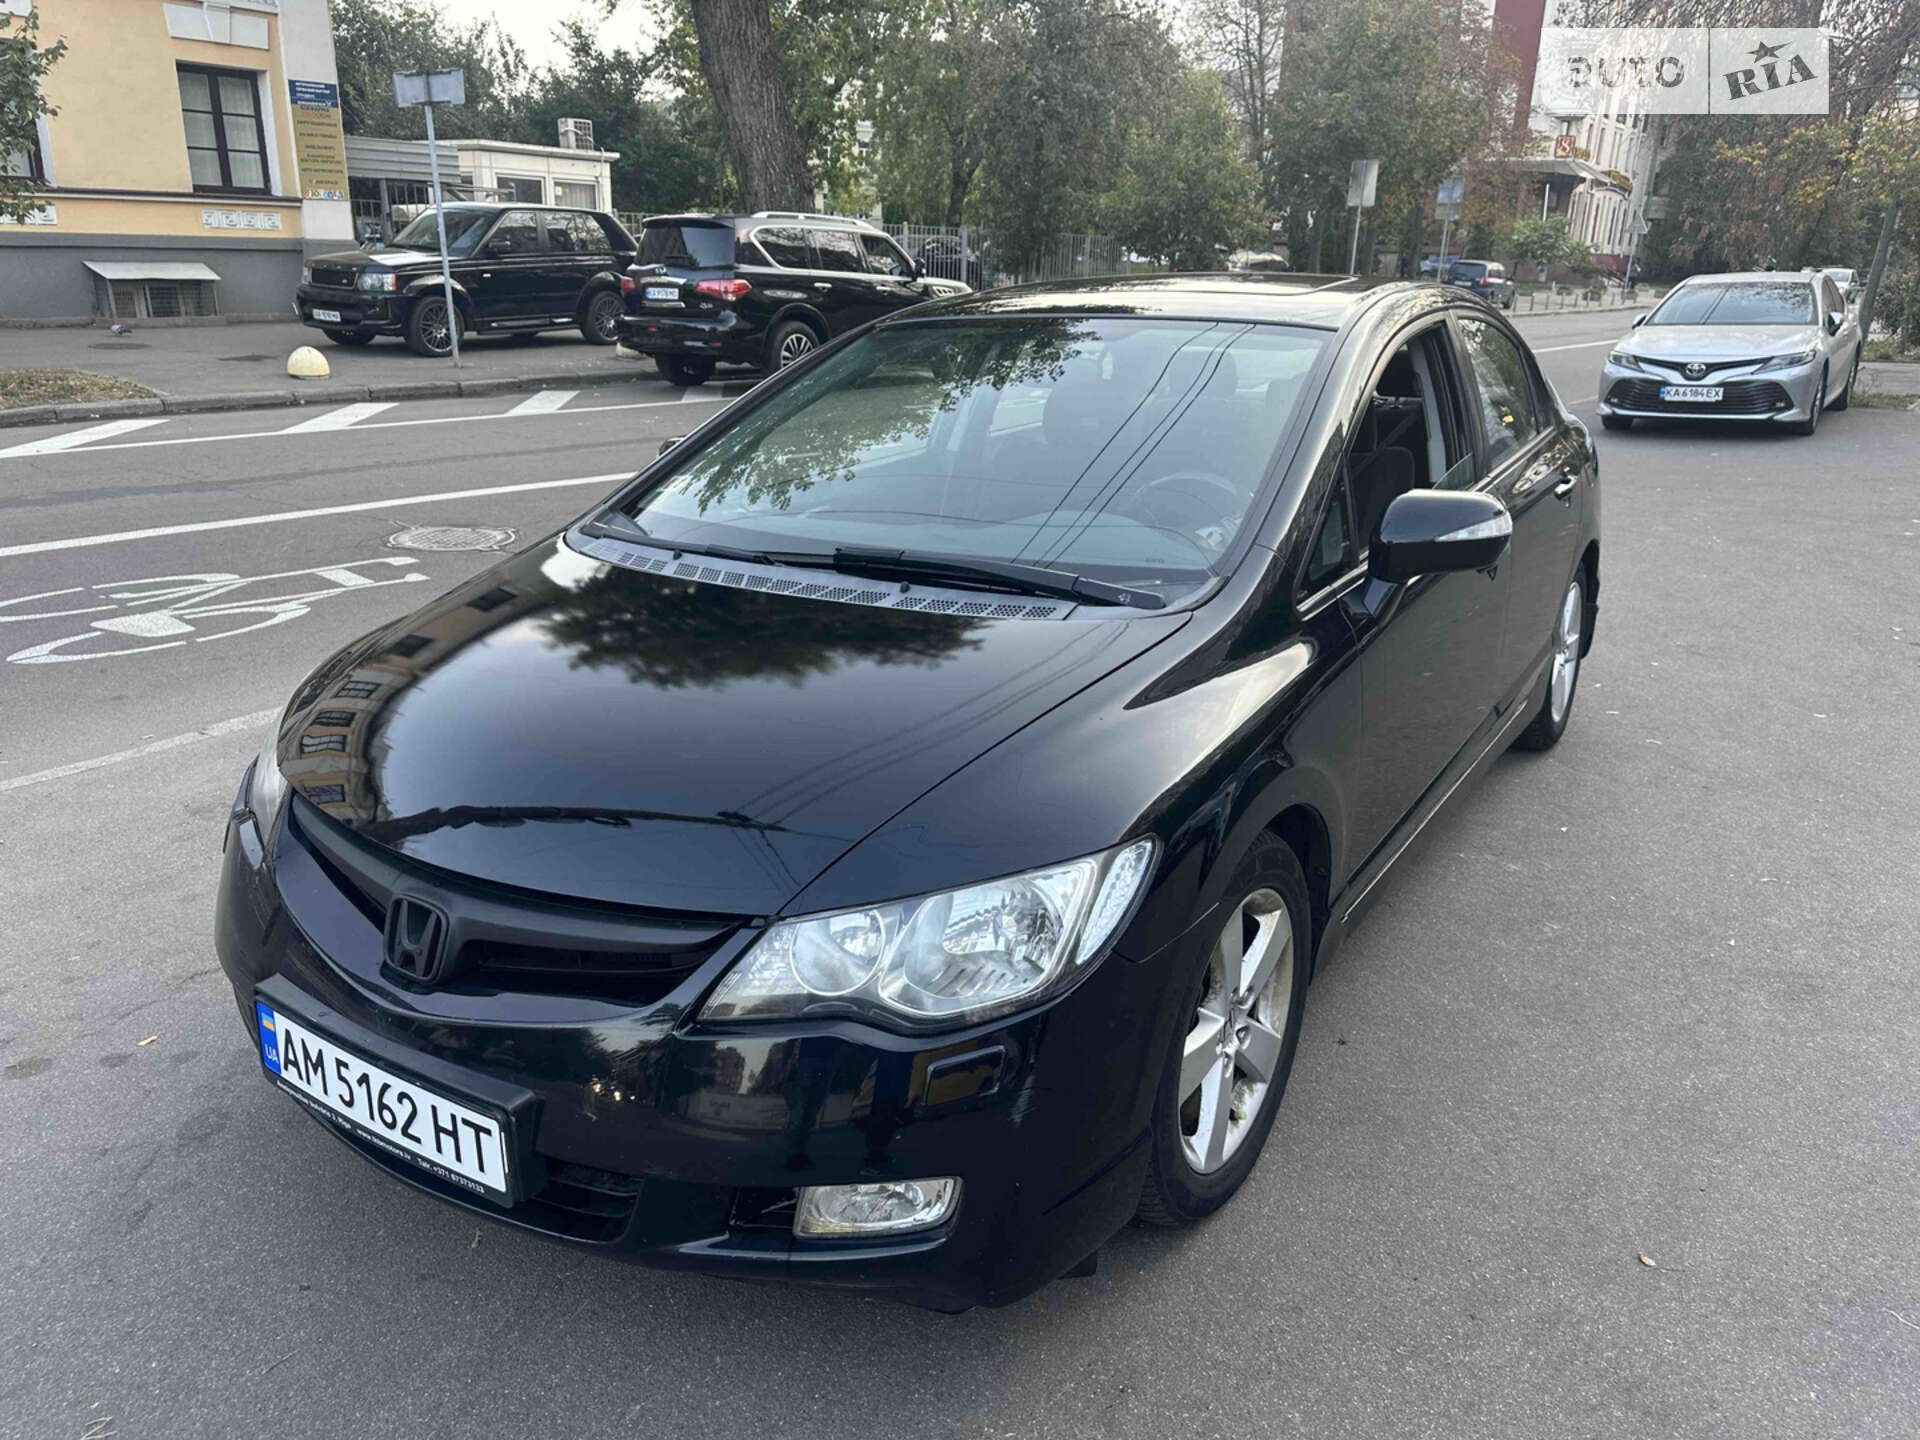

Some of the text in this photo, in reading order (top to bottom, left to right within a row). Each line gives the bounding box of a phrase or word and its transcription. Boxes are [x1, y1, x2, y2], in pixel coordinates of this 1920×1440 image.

[264, 1043, 280, 1065] UA
[283, 1028, 329, 1097] AM
[335, 1057, 422, 1145] 5162
[431, 1104, 492, 1174] HT
